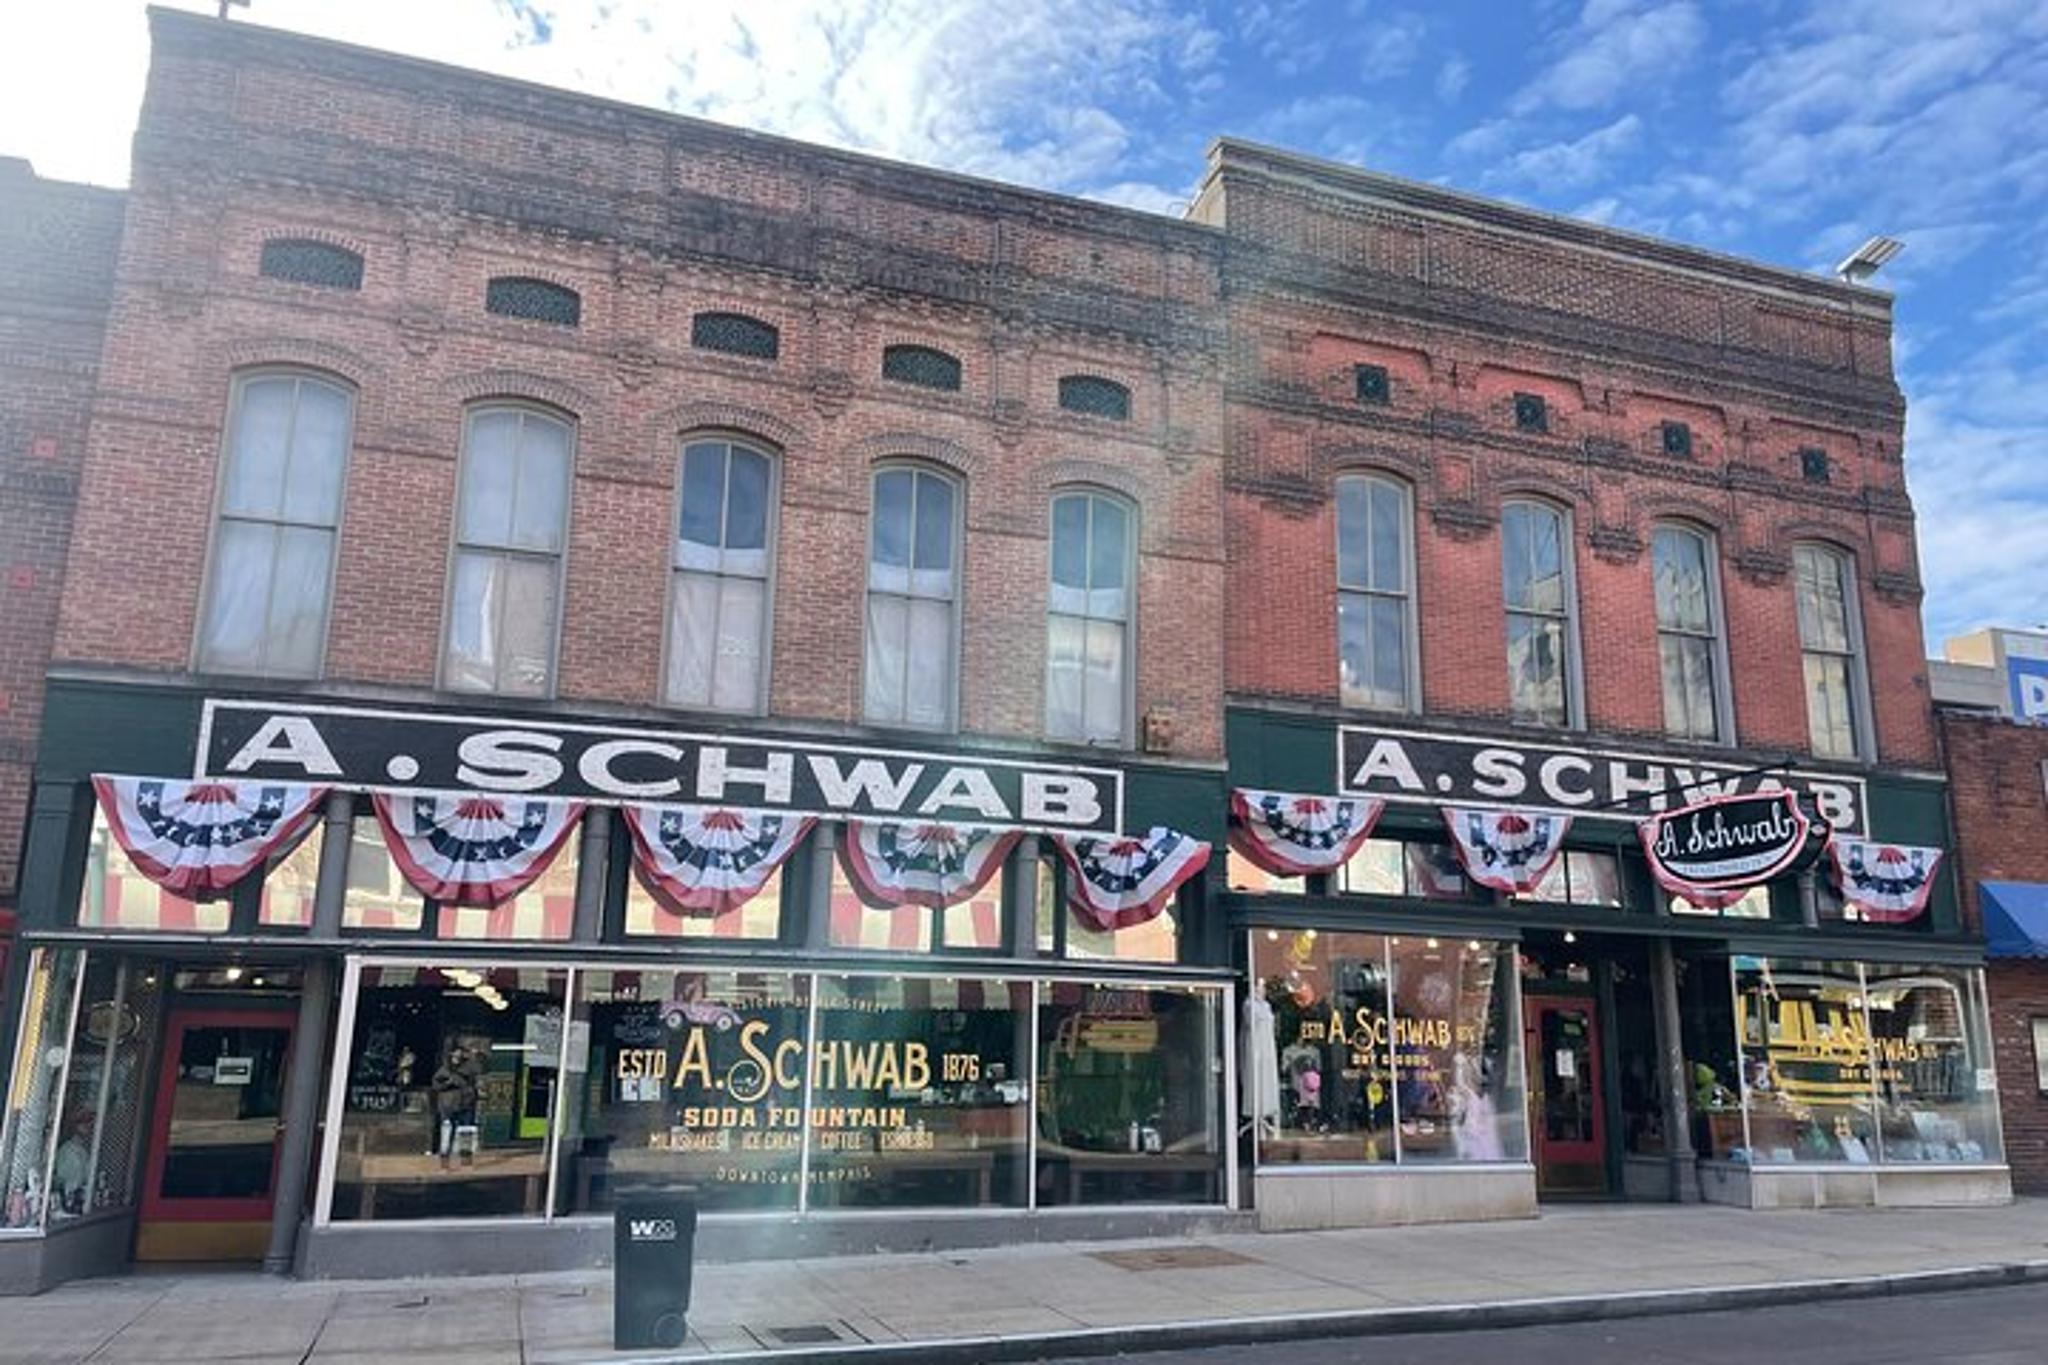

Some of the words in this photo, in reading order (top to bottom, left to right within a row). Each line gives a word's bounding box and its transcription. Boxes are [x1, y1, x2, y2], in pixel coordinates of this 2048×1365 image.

[455, 729, 1102, 825] SCHWAB
[1687, 801, 1797, 852] Schwab
[1353, 1006, 1452, 1051] SCHWAB
[618, 1049, 667, 1078] ESTD
[727, 1019, 930, 1102] SCHWAB
[943, 1054, 979, 1081] 1876
[684, 1108, 756, 1127] SODA
[768, 1108, 905, 1127] FOUNTAIN
